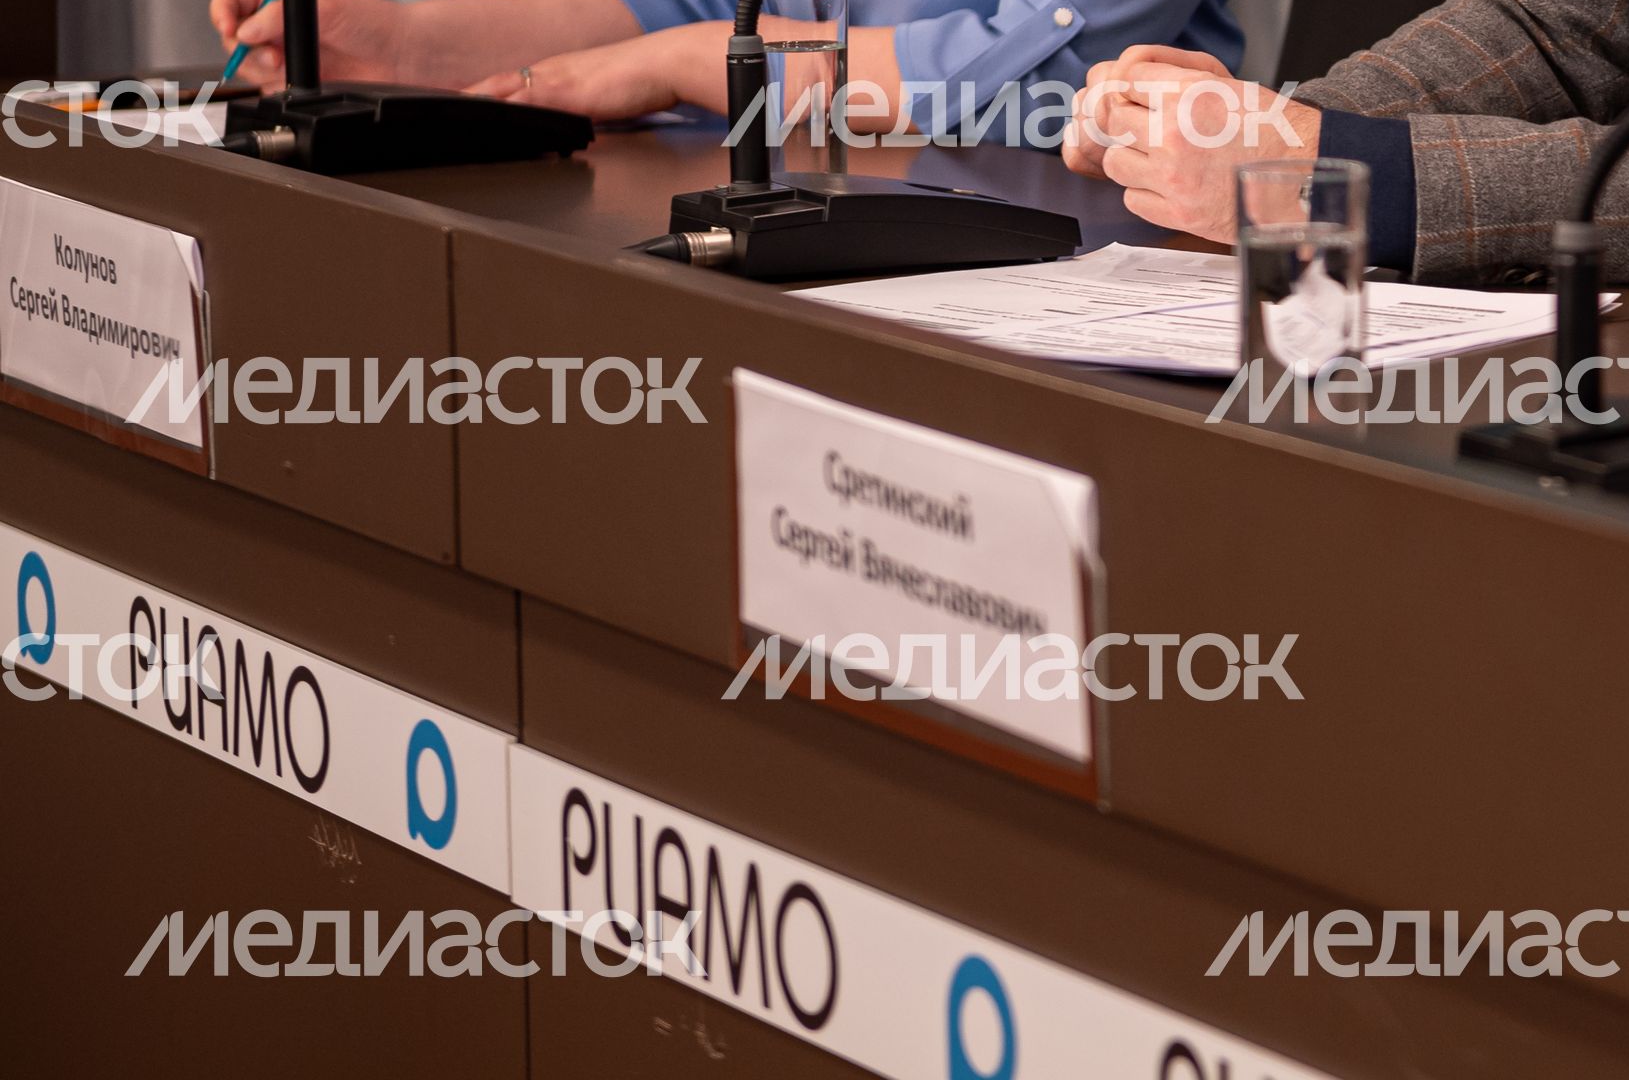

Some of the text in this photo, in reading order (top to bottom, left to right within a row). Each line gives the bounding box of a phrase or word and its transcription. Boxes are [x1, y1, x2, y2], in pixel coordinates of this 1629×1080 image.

[10, 276, 180, 362] Сергей Владимирович
[54, 233, 117, 284] Колунов
[771, 505, 1048, 634] Сергей Вячеславович
[130, 596, 330, 793] РИАМО
[562, 788, 838, 1029] РИАМО
